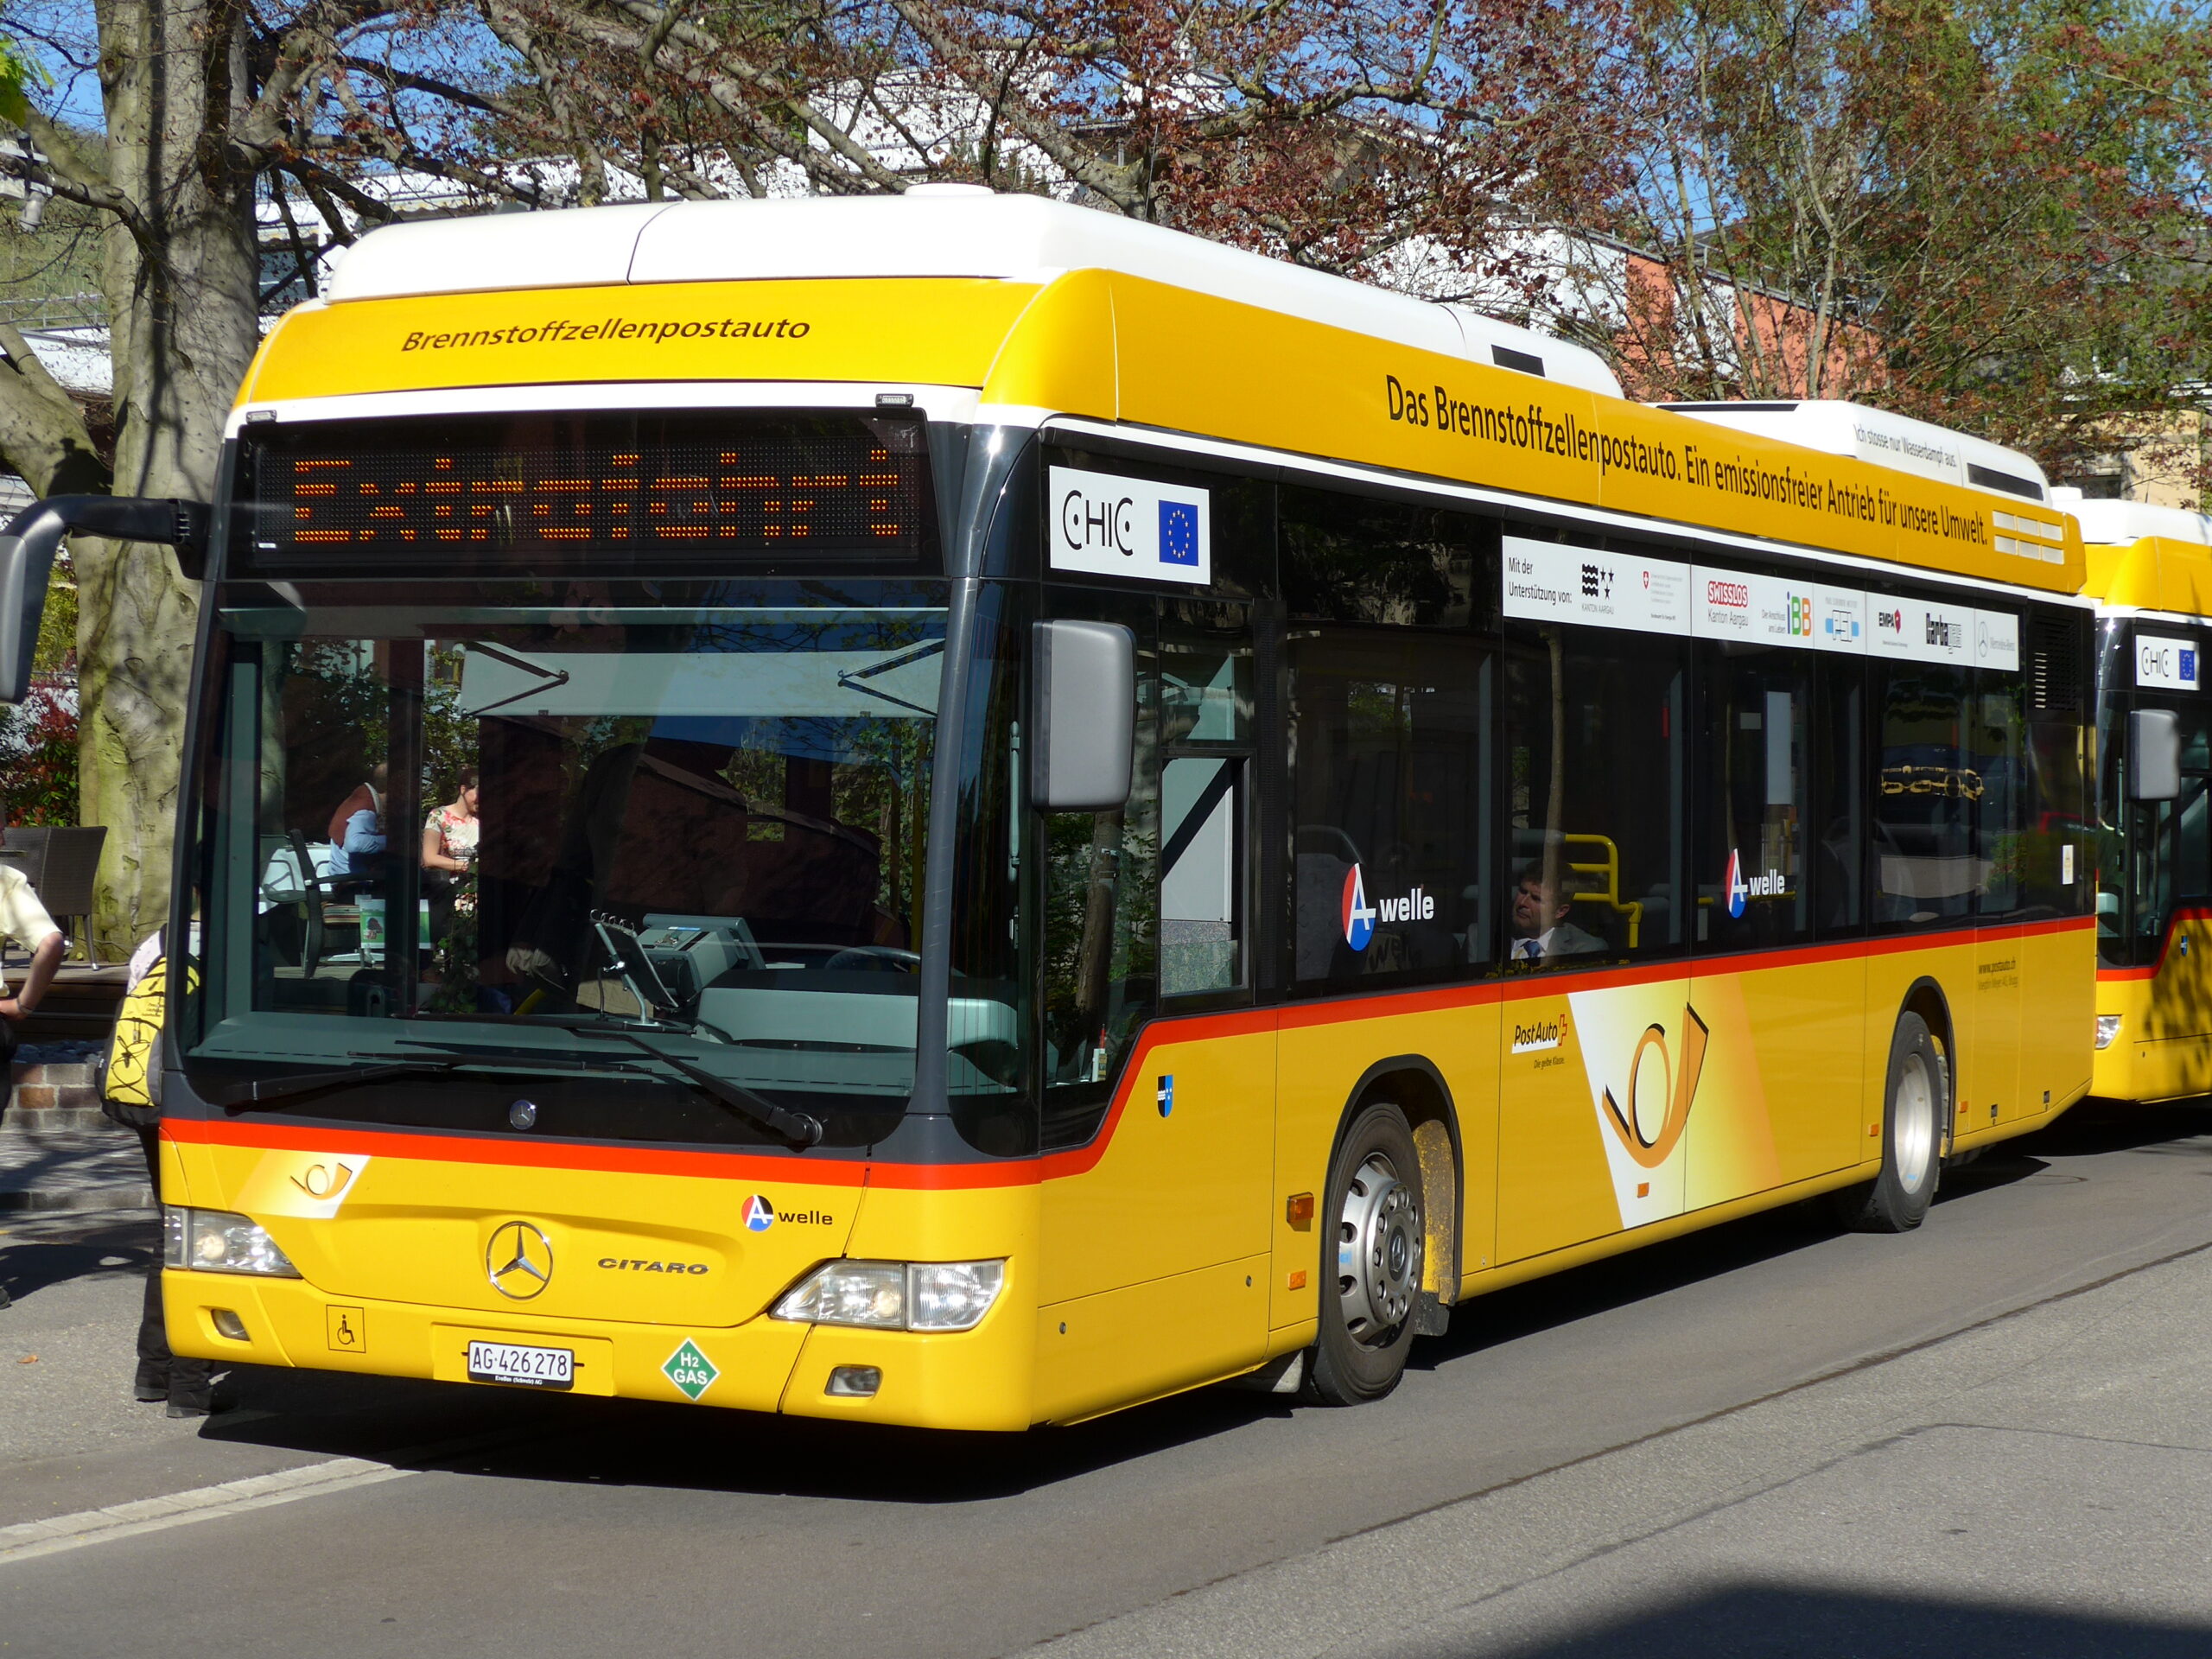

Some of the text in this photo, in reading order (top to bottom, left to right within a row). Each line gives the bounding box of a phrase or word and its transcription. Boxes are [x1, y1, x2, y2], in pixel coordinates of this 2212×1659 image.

[401, 318, 810, 352] Brennstoffzellenpostauto
[1853, 423, 1866, 443] Ich
[1867, 429, 1889, 449] stosse
[1890, 436, 1900, 452] nur
[1901, 435, 1944, 468] Wasserdampf
[1386, 374, 1988, 545] Das Brennstoffzellenpostauto. Ein emissionsfreier Antrieb für unsere Umwelt.
[1062, 489, 1134, 556] CHIC
[1509, 556, 1534, 575] Mit der
[1509, 581, 1573, 606] Unterstützung von:
[1707, 580, 1749, 608] SWISSLOS
[1707, 607, 1749, 629] Kanton Aargau
[2141, 646, 2170, 677] CHIC
[1750, 869, 1786, 897] welle
[1380, 888, 1434, 923] welle
[1514, 1021, 1558, 1046] PostAuto
[778, 1211, 833, 1225] welle
[597, 1257, 709, 1275] CITARO
[680, 1351, 700, 1368] H2
[673, 1368, 708, 1385] GAS
